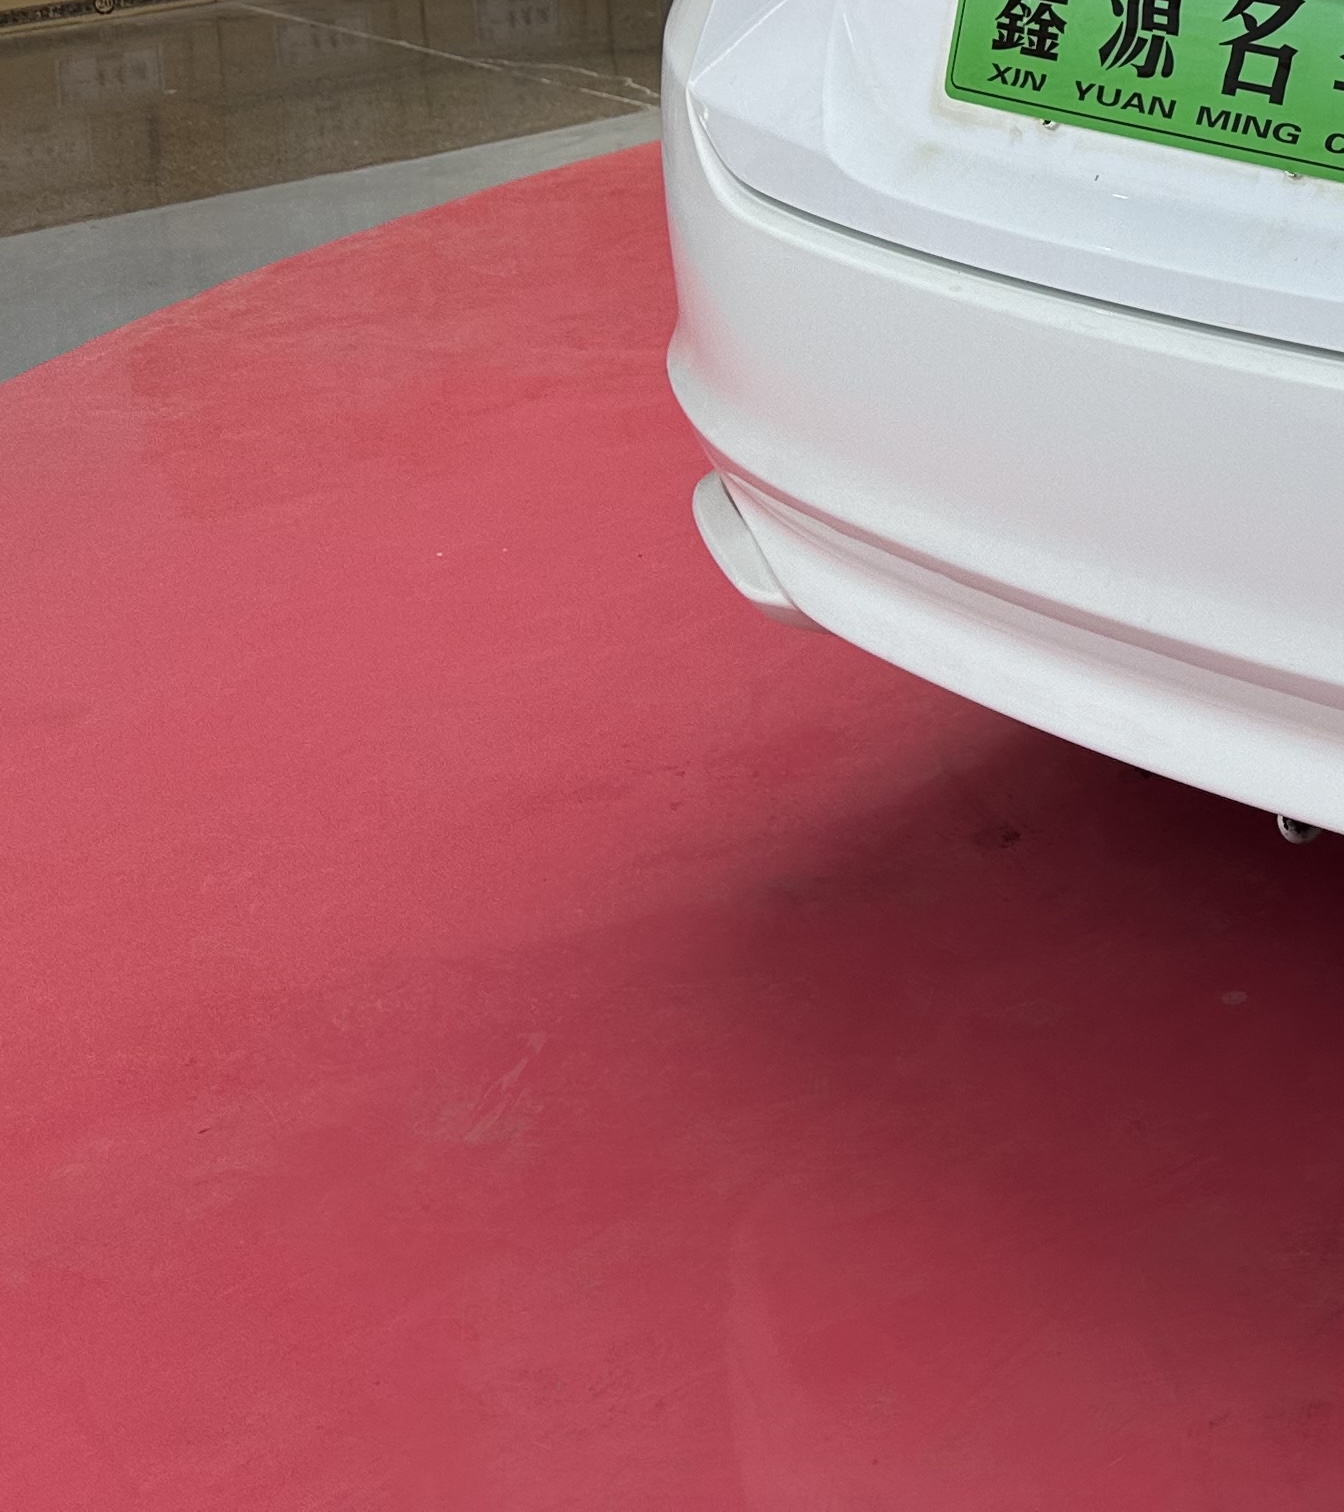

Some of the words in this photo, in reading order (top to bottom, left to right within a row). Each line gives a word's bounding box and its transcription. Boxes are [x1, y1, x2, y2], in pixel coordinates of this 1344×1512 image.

[988, 63, 1047, 92] XIN
[1075, 80, 1176, 120] YUAN
[1196, 105, 1301, 145] MING
